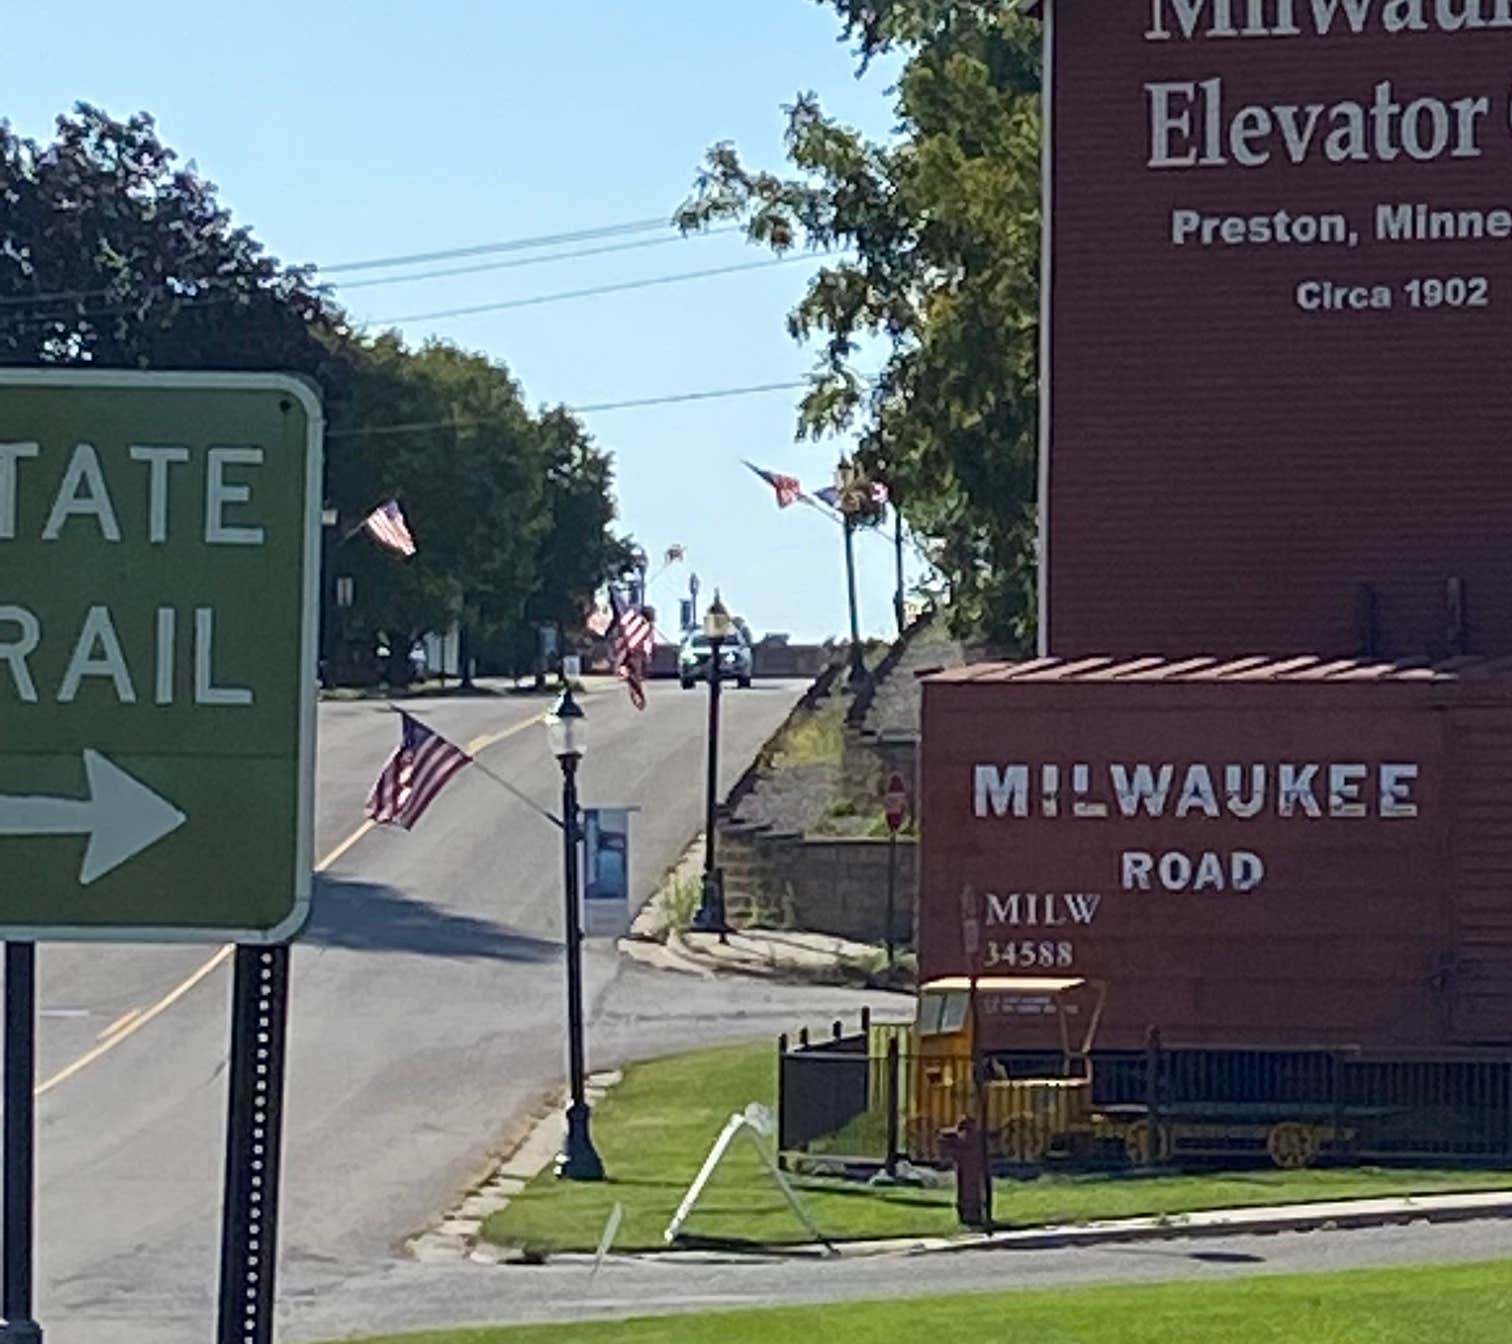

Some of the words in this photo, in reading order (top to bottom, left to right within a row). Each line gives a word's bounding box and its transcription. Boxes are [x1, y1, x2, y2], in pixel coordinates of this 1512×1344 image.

[1144, 77, 1489, 168] Elevator
[1171, 209, 1359, 246] Preston,
[1296, 280, 1392, 309] Circa
[1404, 276, 1489, 308] 1902
[0, 442, 264, 544] TATE
[0, 605, 253, 704] RAIL
[974, 763, 1419, 818] MILWAUKEE
[1121, 851, 1264, 890] ROAD
[985, 893, 1101, 926] MILW
